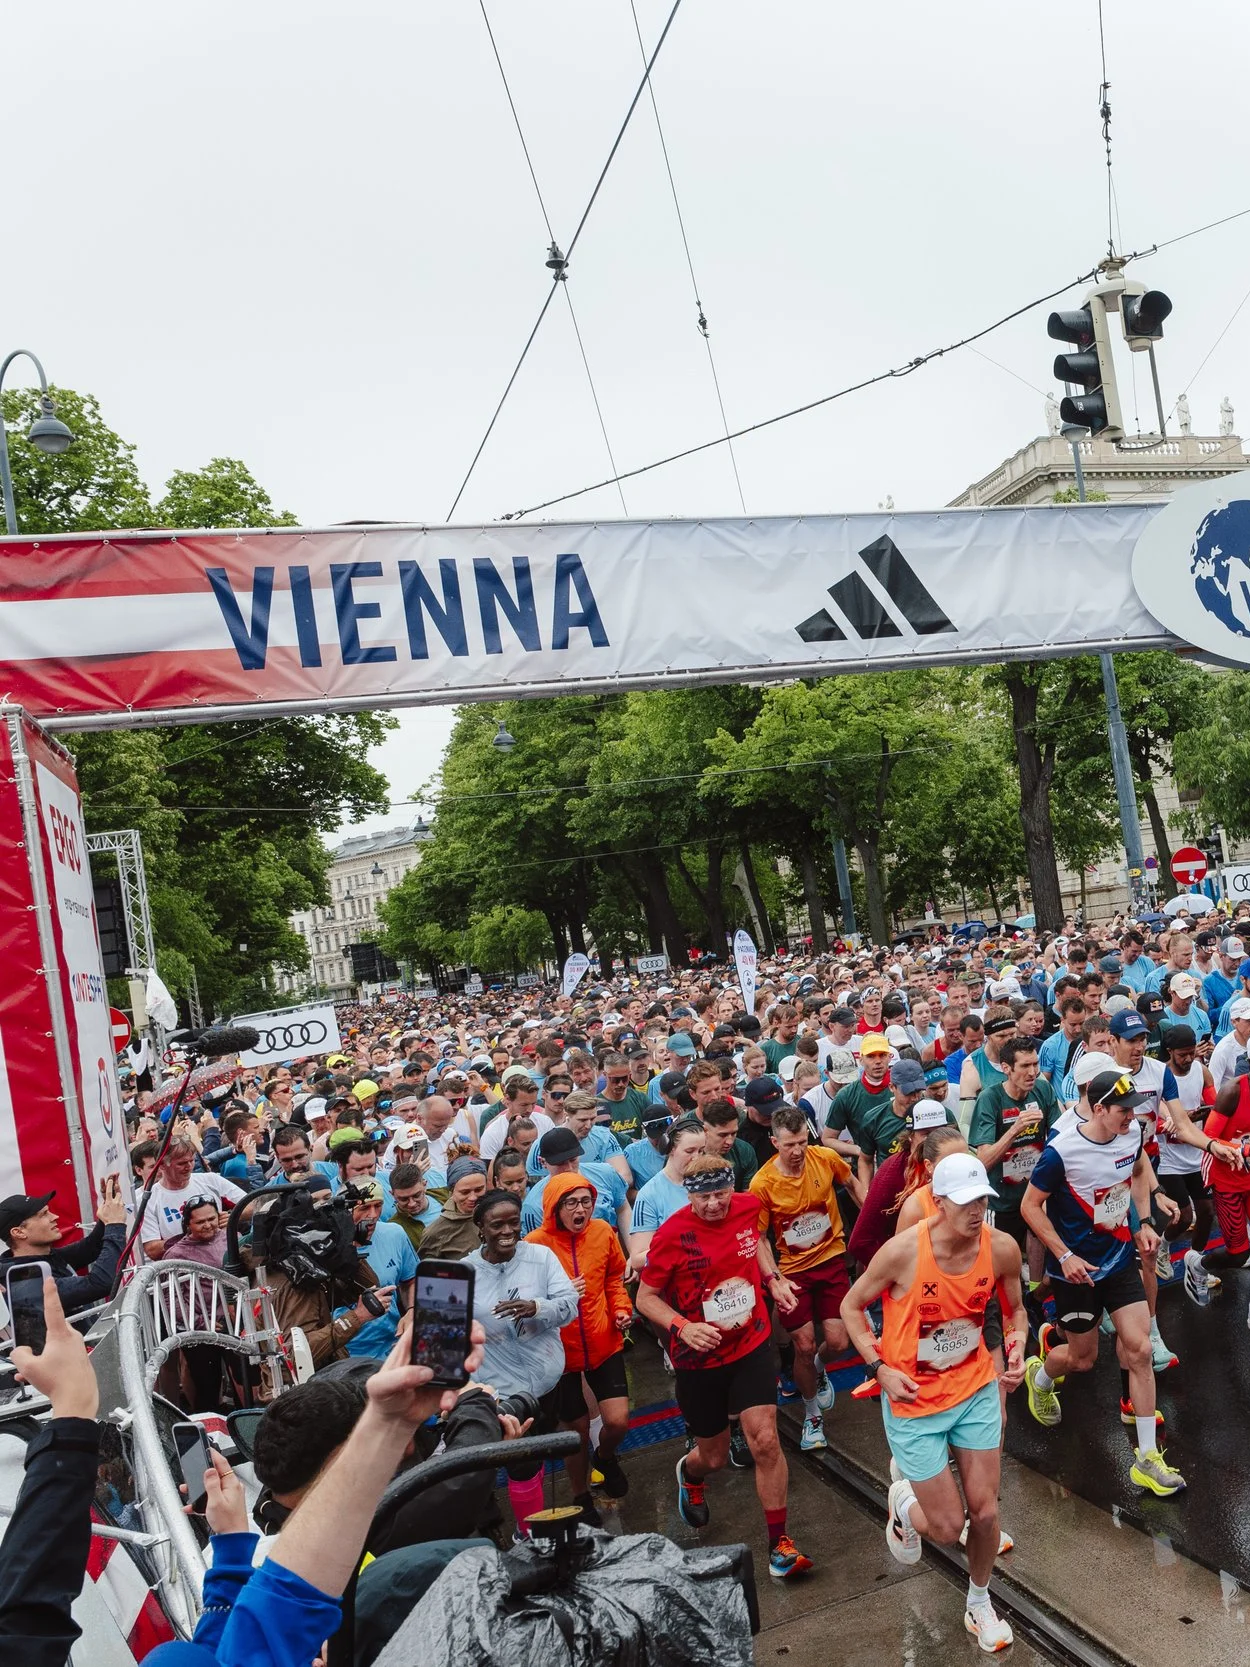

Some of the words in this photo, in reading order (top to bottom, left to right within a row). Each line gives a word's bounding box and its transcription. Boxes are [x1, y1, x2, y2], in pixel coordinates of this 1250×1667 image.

[204, 553, 611, 671] VIENNA
[49, 803, 82, 876] ERGO
[717, 1295, 748, 1313] 36416
[933, 1336, 969, 1353] 46953
